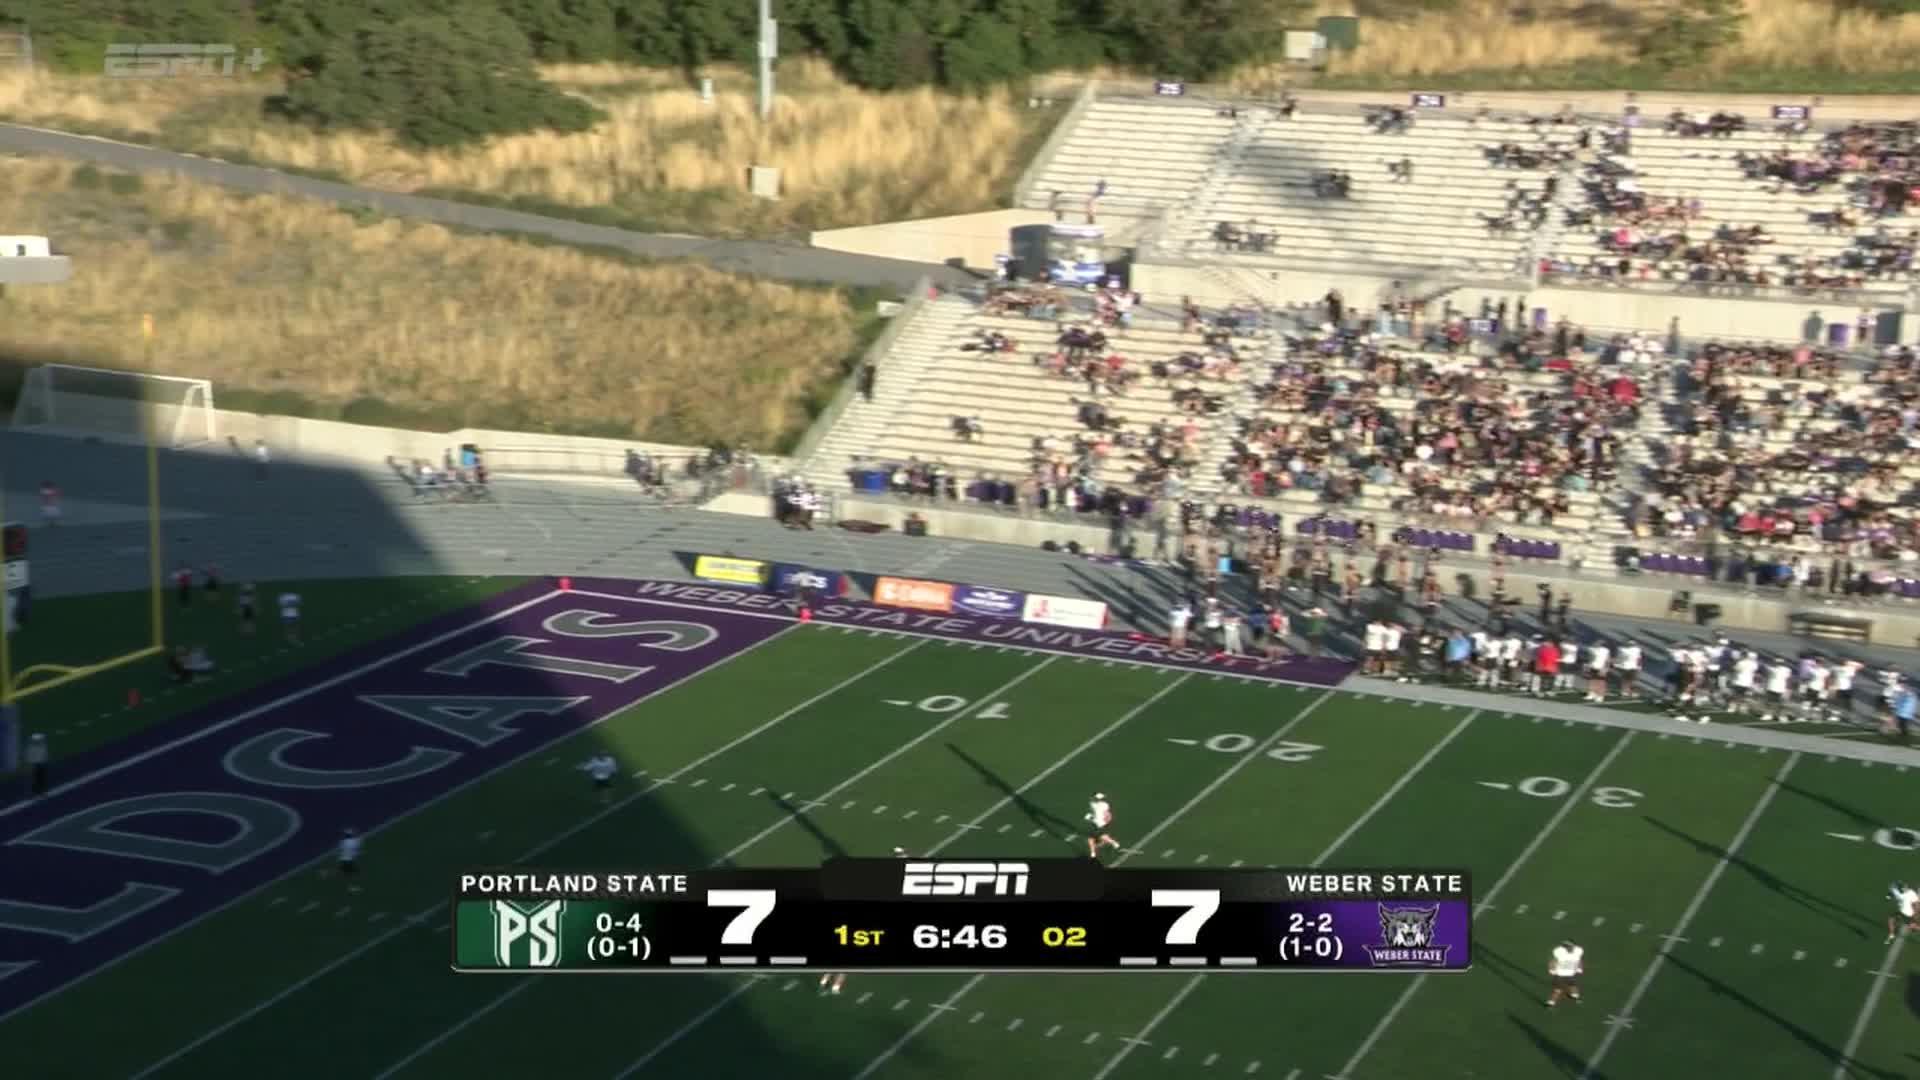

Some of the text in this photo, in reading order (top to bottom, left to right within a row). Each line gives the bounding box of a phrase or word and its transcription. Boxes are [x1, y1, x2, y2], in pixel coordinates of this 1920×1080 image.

[637, 581, 802, 613] WEBER
[814, 604, 977, 634] STATE
[0, 609, 719, 978] LDCATS
